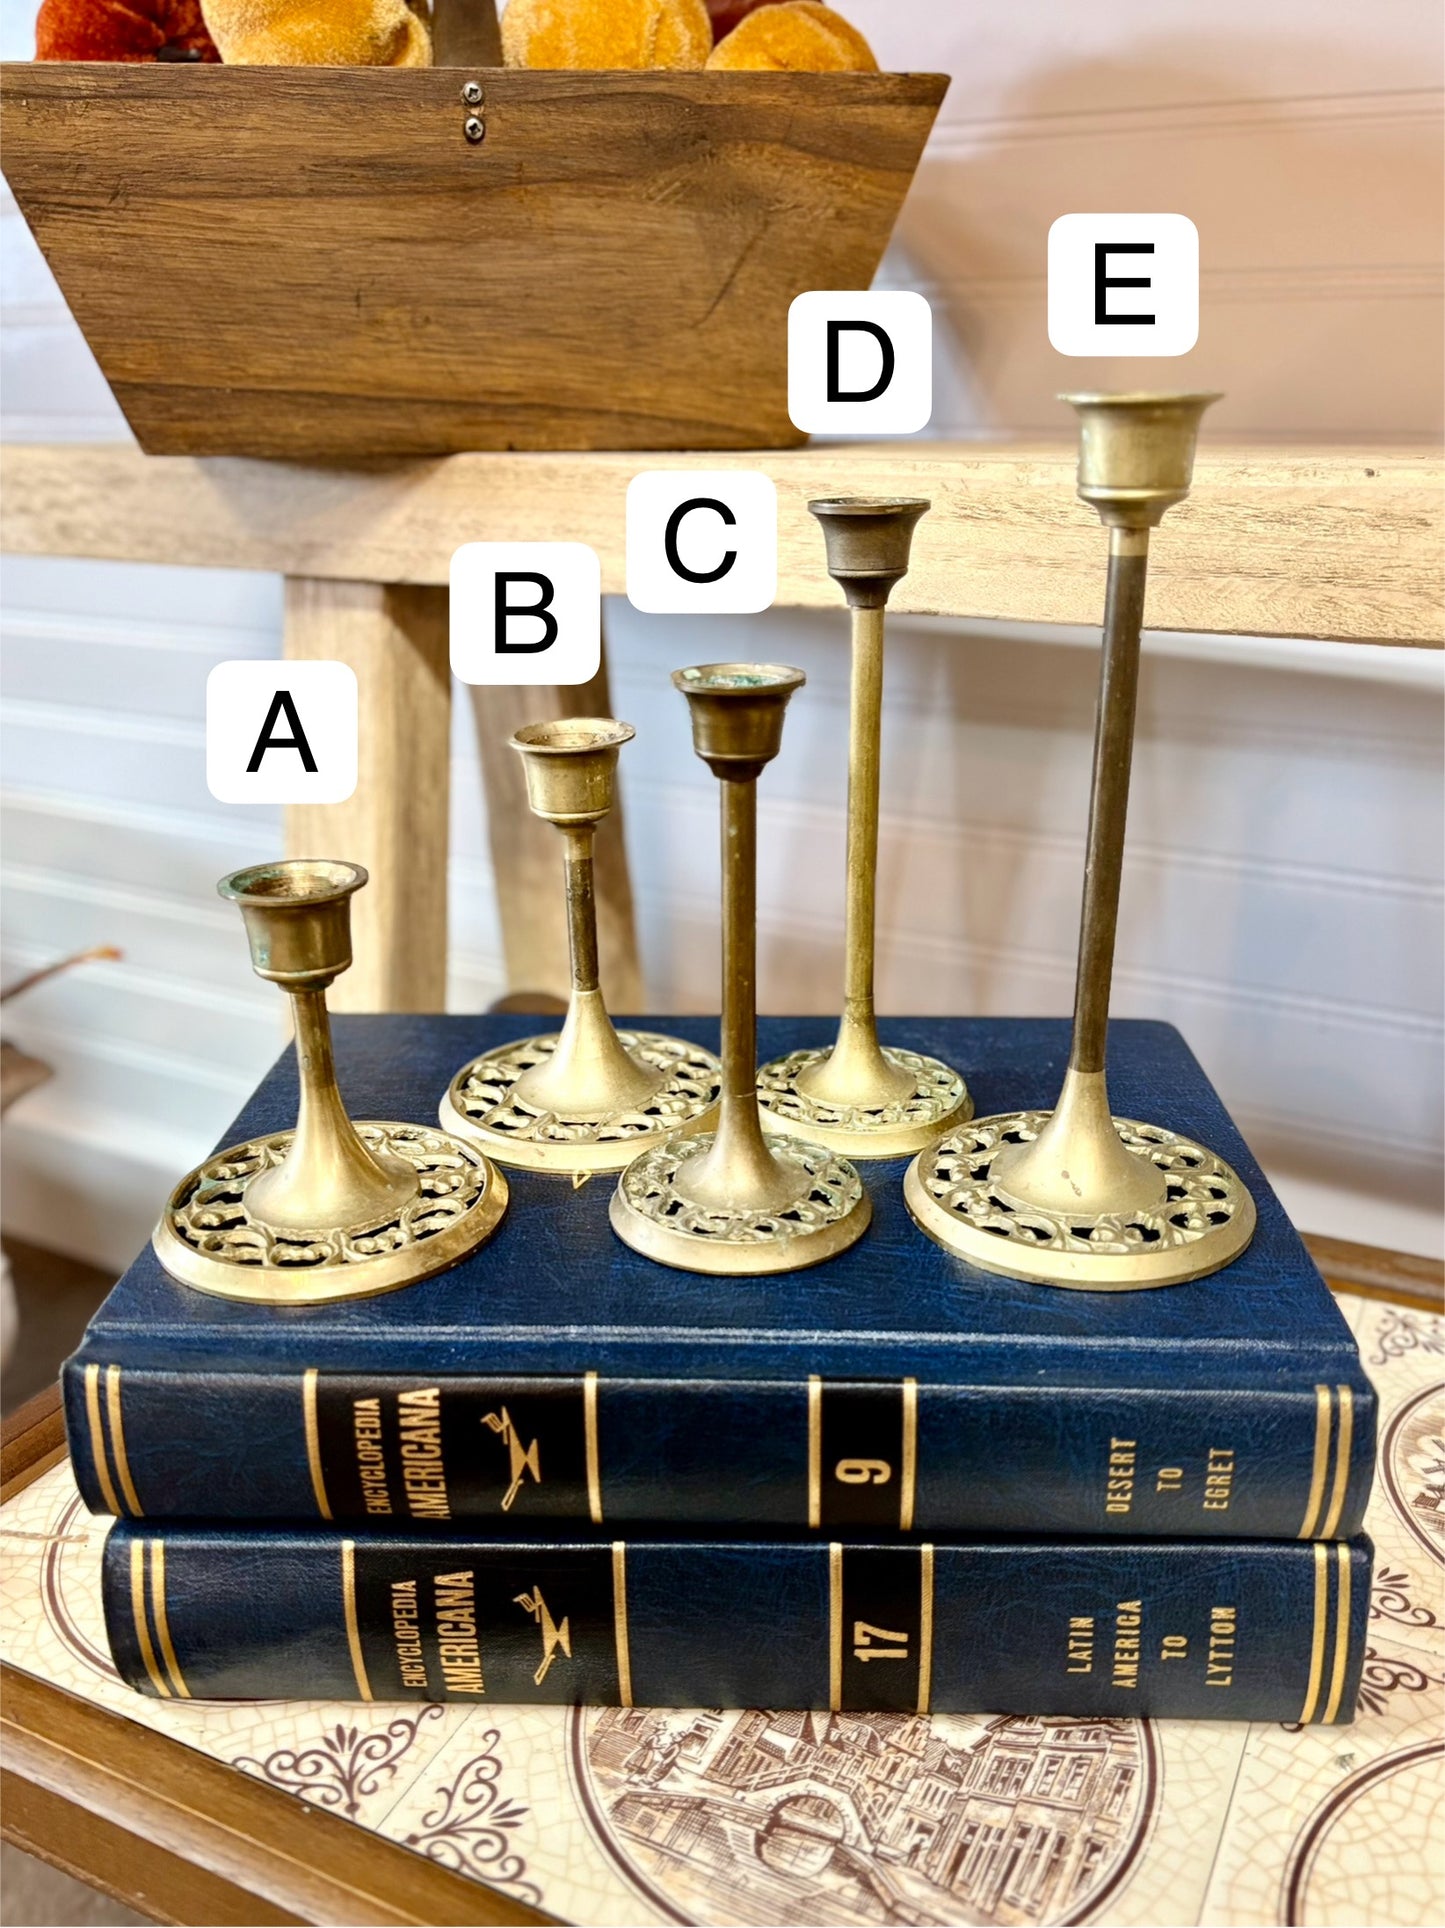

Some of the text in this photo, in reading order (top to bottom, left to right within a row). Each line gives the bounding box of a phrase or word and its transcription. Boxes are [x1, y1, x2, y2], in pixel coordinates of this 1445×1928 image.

[353, 1398, 393, 1514] ENCYCLOPEDIA
[398, 1387, 452, 1520] AMERICANA
[834, 1457, 892, 1486] 9
[1105, 1437, 1137, 1514] DESERT
[1156, 1467, 1184, 1493] TO
[1203, 1448, 1235, 1511] EGRET
[391, 1580, 428, 1689] ENCYCLOPEDIA
[433, 1570, 486, 1694] AMERICANA
[853, 1620, 909, 1663] 17
[1066, 1616, 1095, 1674] LATIN
[1111, 1599, 1143, 1689] AMERICA
[1160, 1635, 1189, 1661] TO
[1205, 1606, 1237, 1688] LYTTON
